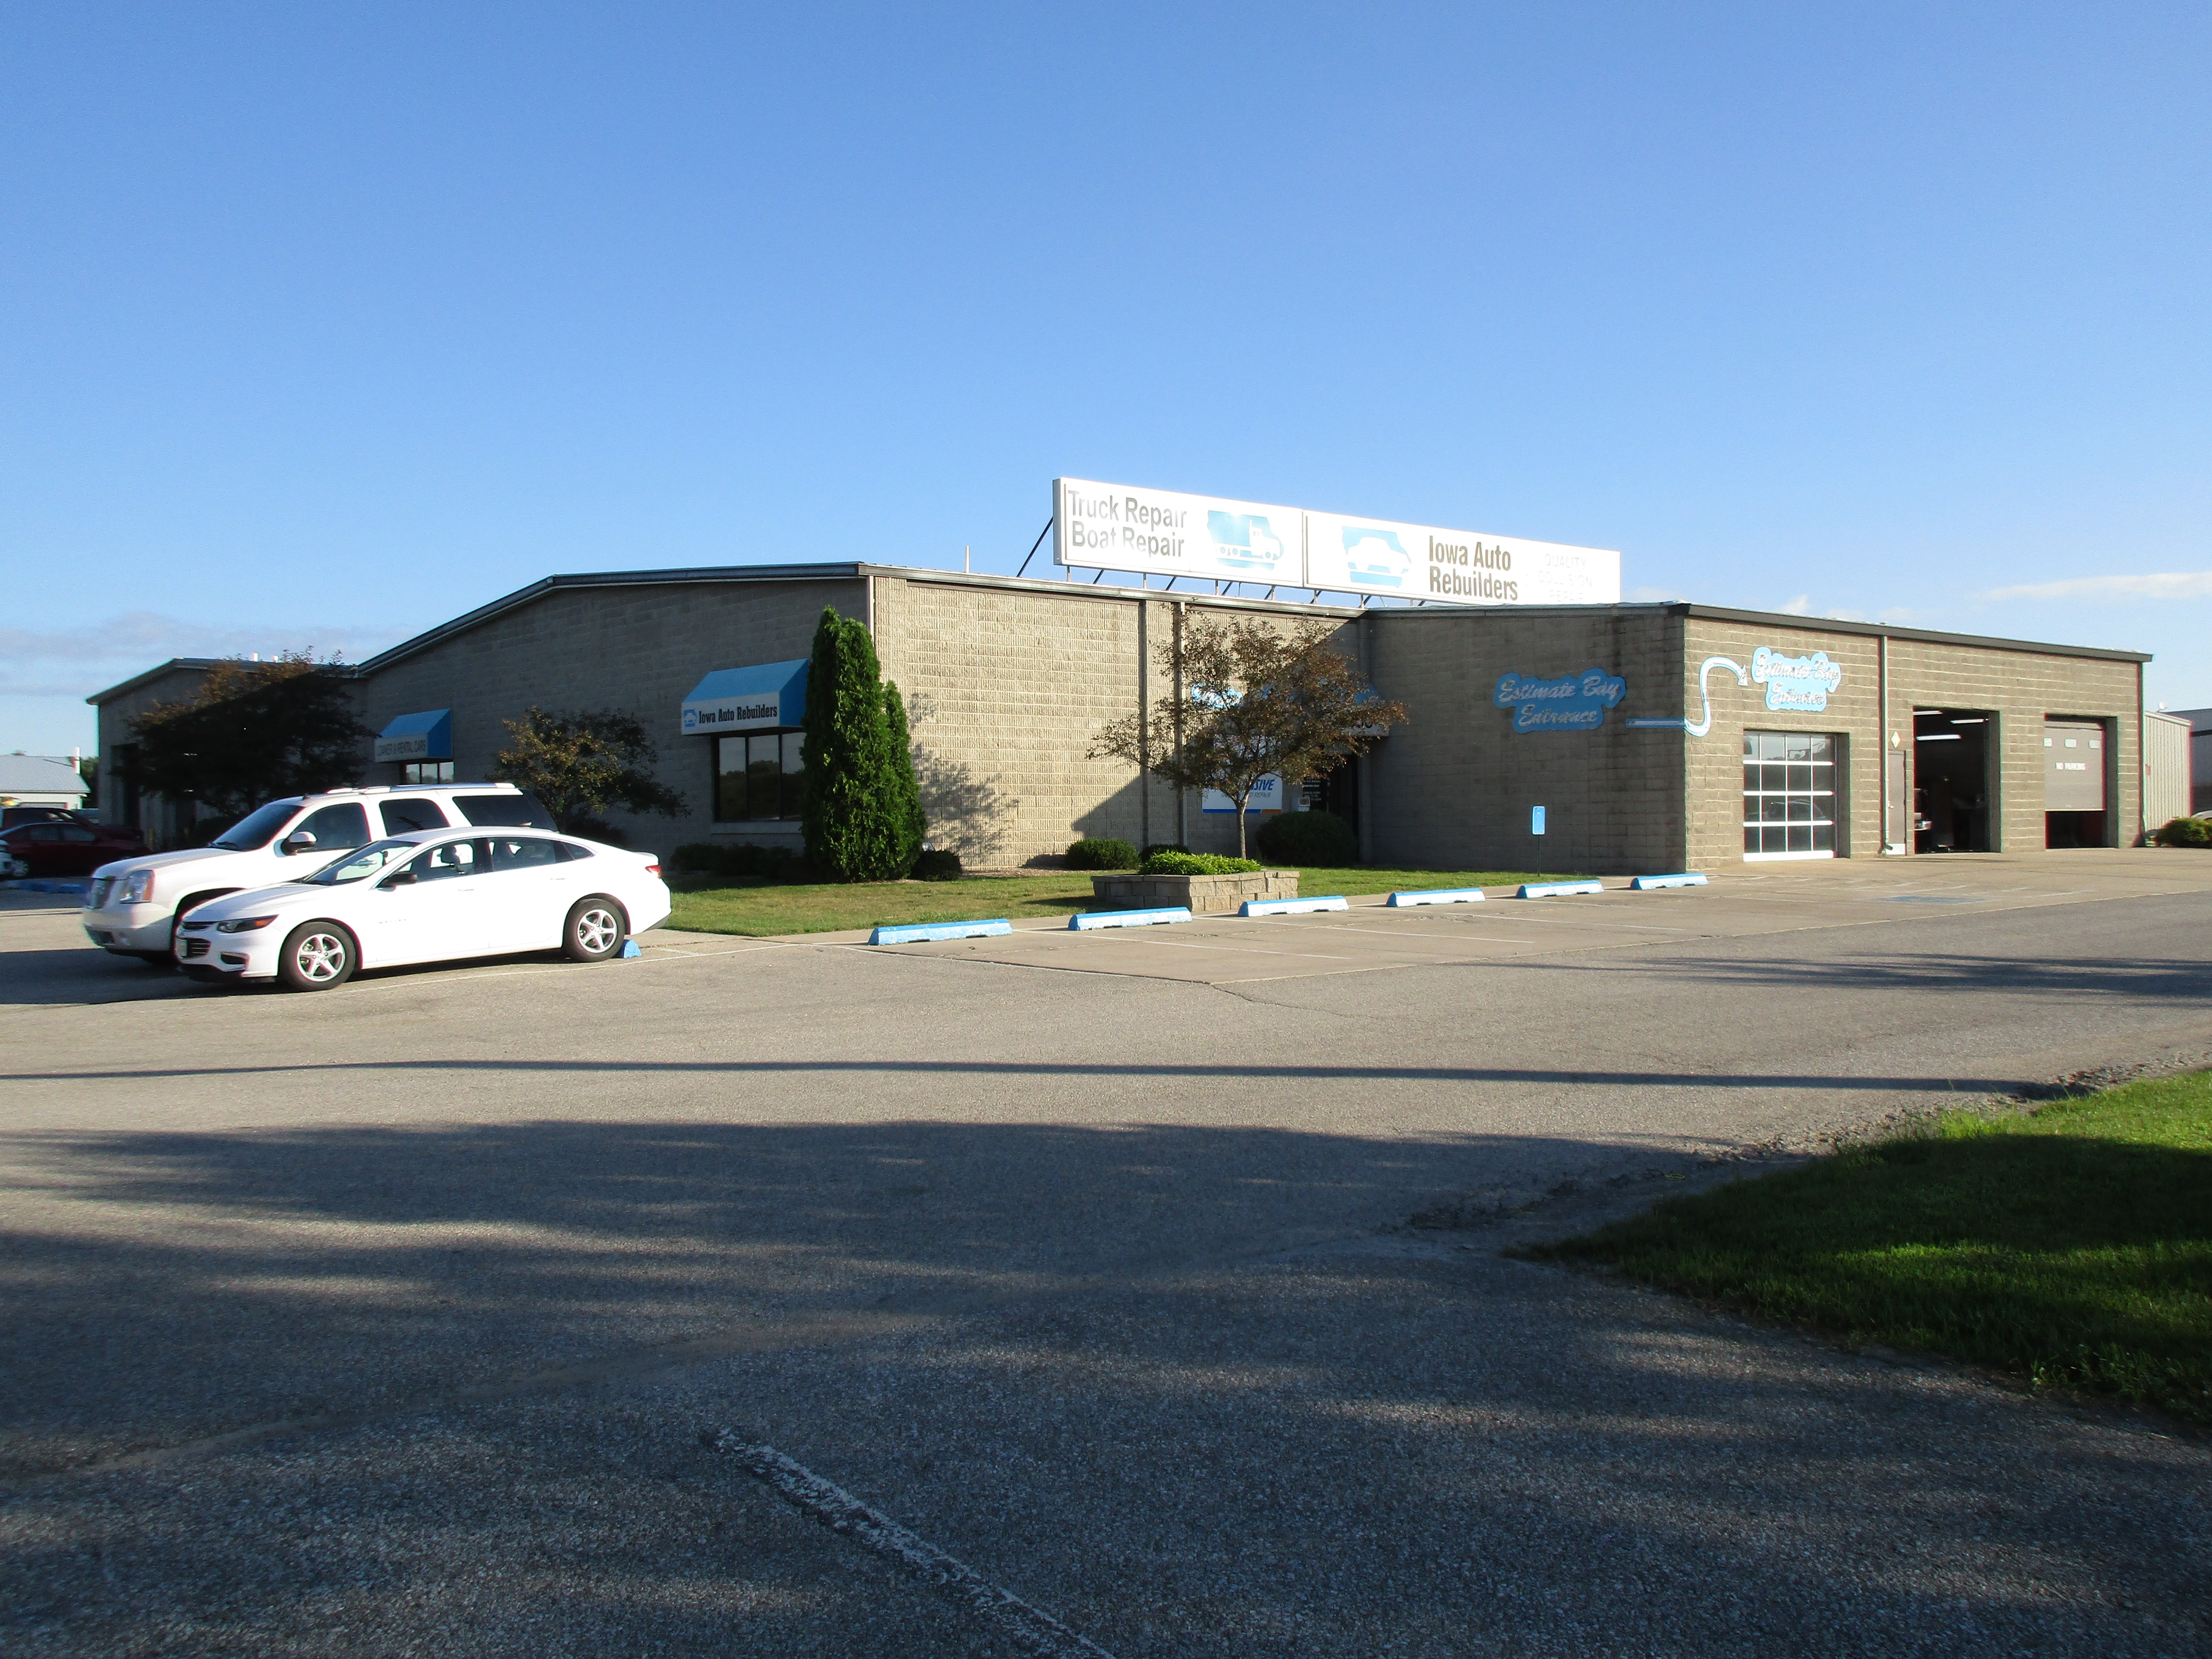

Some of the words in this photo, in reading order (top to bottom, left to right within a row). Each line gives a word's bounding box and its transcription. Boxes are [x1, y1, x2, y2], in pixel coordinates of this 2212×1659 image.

[1068, 489, 1119, 521] Truck
[1125, 497, 1187, 532] Repair
[1072, 520, 1116, 549] Boat
[1122, 526, 1185, 558] Repair
[1428, 535, 1468, 567] Iowa
[1474, 541, 1511, 571] Auto
[1545, 553, 1587, 569] QUALITY
[1429, 565, 1518, 601] Rebuilders
[1538, 570, 1592, 587] COLLISION
[1499, 679, 1576, 702] Estimate
[1583, 675, 1620, 701] Bay
[699, 710, 716, 724] Iowa
[718, 708, 735, 722] Auto
[736, 704, 778, 721] Rebuilders
[1518, 704, 1598, 727] Entrance
[2064, 762, 2087, 771] PARKING
